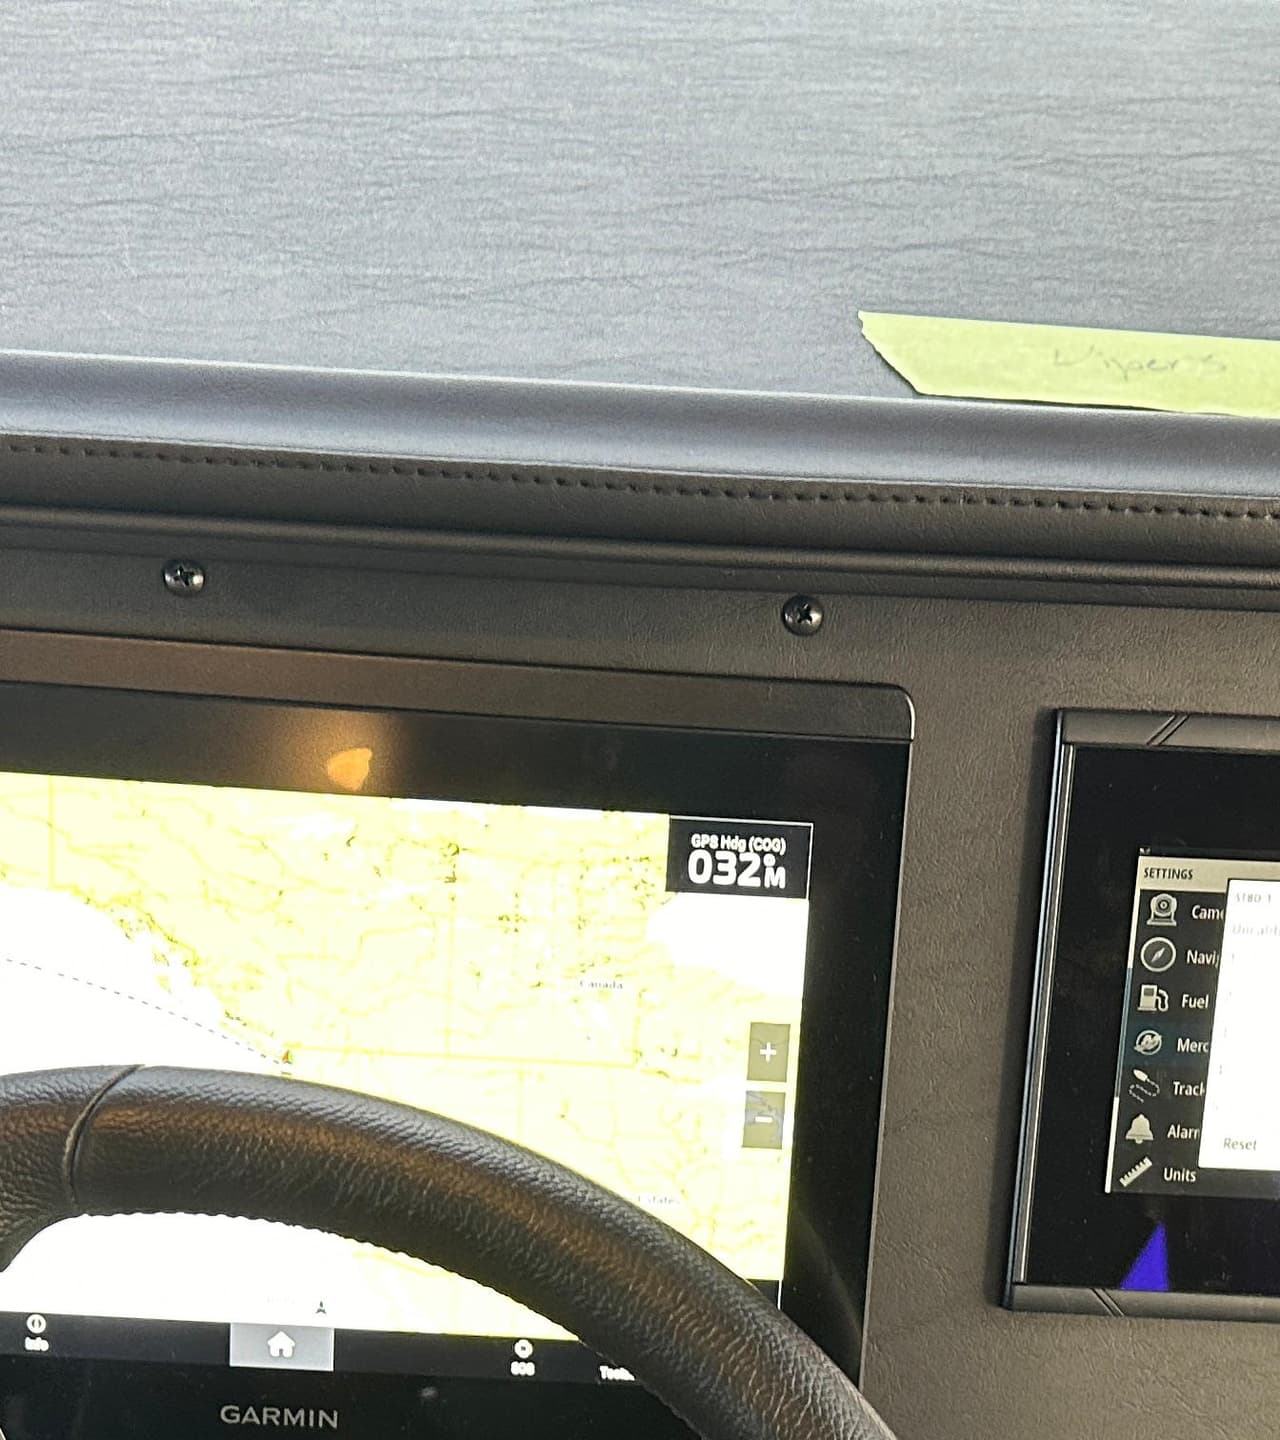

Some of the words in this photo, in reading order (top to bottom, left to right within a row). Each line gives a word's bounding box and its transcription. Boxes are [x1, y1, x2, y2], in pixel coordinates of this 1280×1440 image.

[691, 833, 718, 850] GPS
[1144, 867, 1194, 880] SETTINGS
[1181, 993, 1209, 1009] Fuel
[1223, 1137, 1257, 1151] Reset
[1163, 1167, 1197, 1183] Units
[220, 1404, 339, 1430] GARMIN
